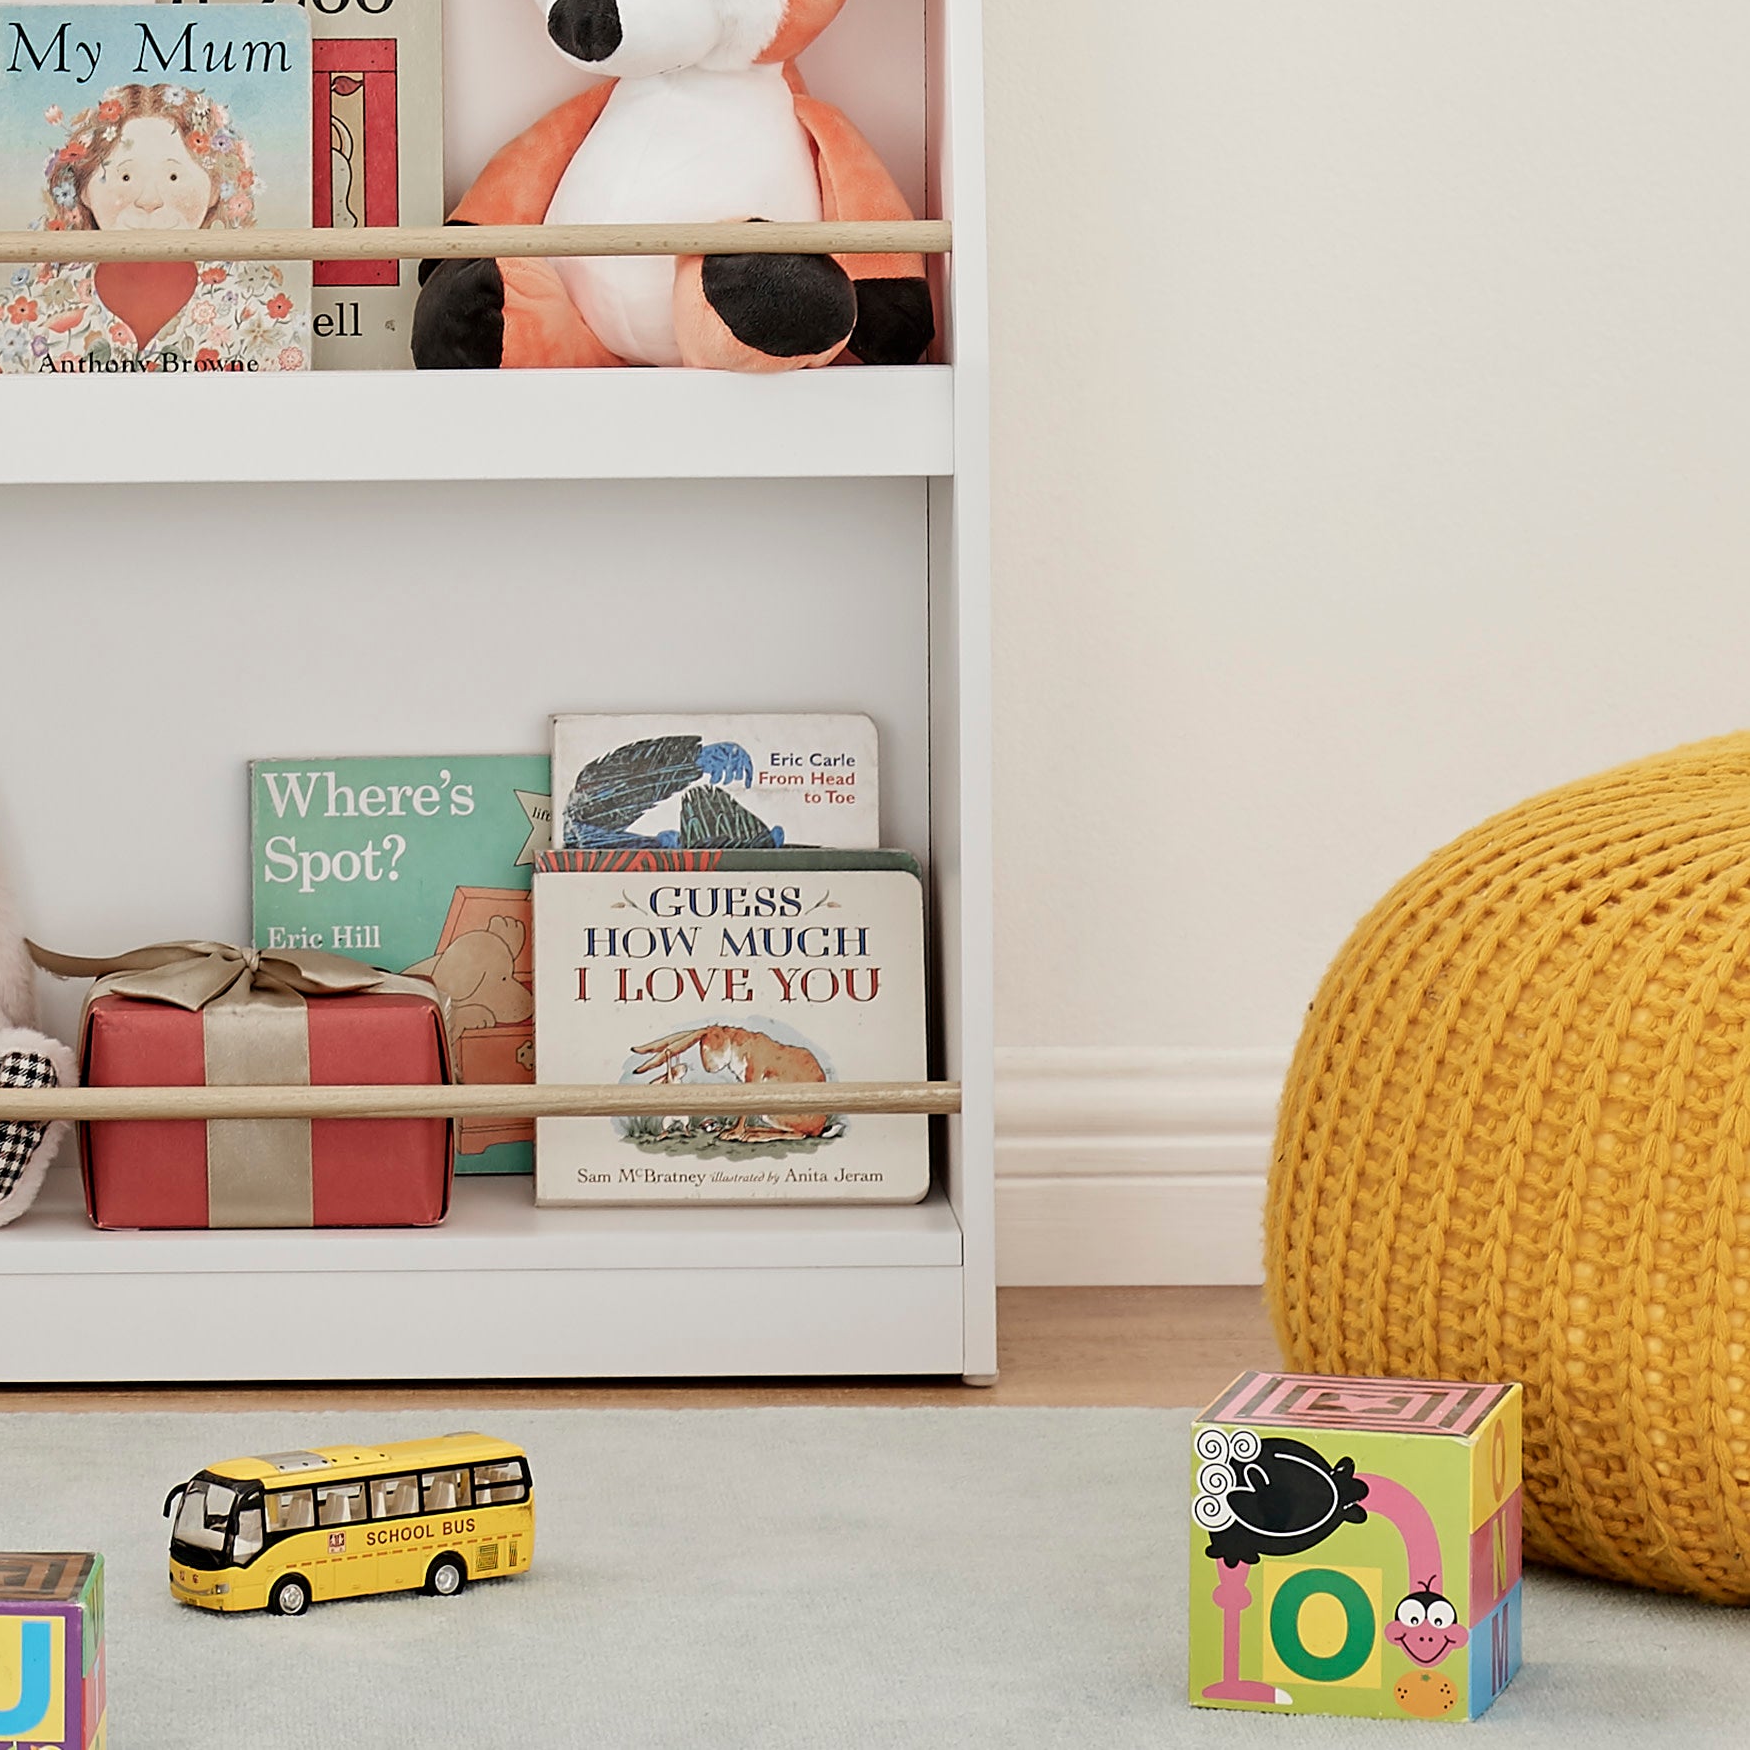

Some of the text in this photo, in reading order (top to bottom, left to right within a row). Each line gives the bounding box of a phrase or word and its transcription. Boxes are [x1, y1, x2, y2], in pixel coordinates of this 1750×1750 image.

[6, 22, 292, 84] My Mum
[313, 302, 362, 337] ell
[160, 352, 260, 373] Browne
[770, 753, 856, 767] Eric Carle
[261, 769, 476, 819] Where's
[759, 771, 855, 785] From Head
[804, 790, 856, 804] to Toe
[263, 833, 407, 894] Spot?
[650, 886, 804, 918] GUESS
[267, 925, 382, 950] Eric Hill
[583, 926, 872, 959] HOW MUCH
[574, 966, 883, 1003] I LOVE YOU
[577, 1168, 612, 1184] Sam
[710, 1171, 766, 1184] illustrated
[766, 1171, 781, 1185] by
[784, 1168, 828, 1183] Anita
[834, 1168, 884, 1183] Jeram
[366, 1517, 476, 1547] SCHOOL BUS
[1492, 1509, 1507, 1601] N
[1270, 1568, 1375, 1682] O
